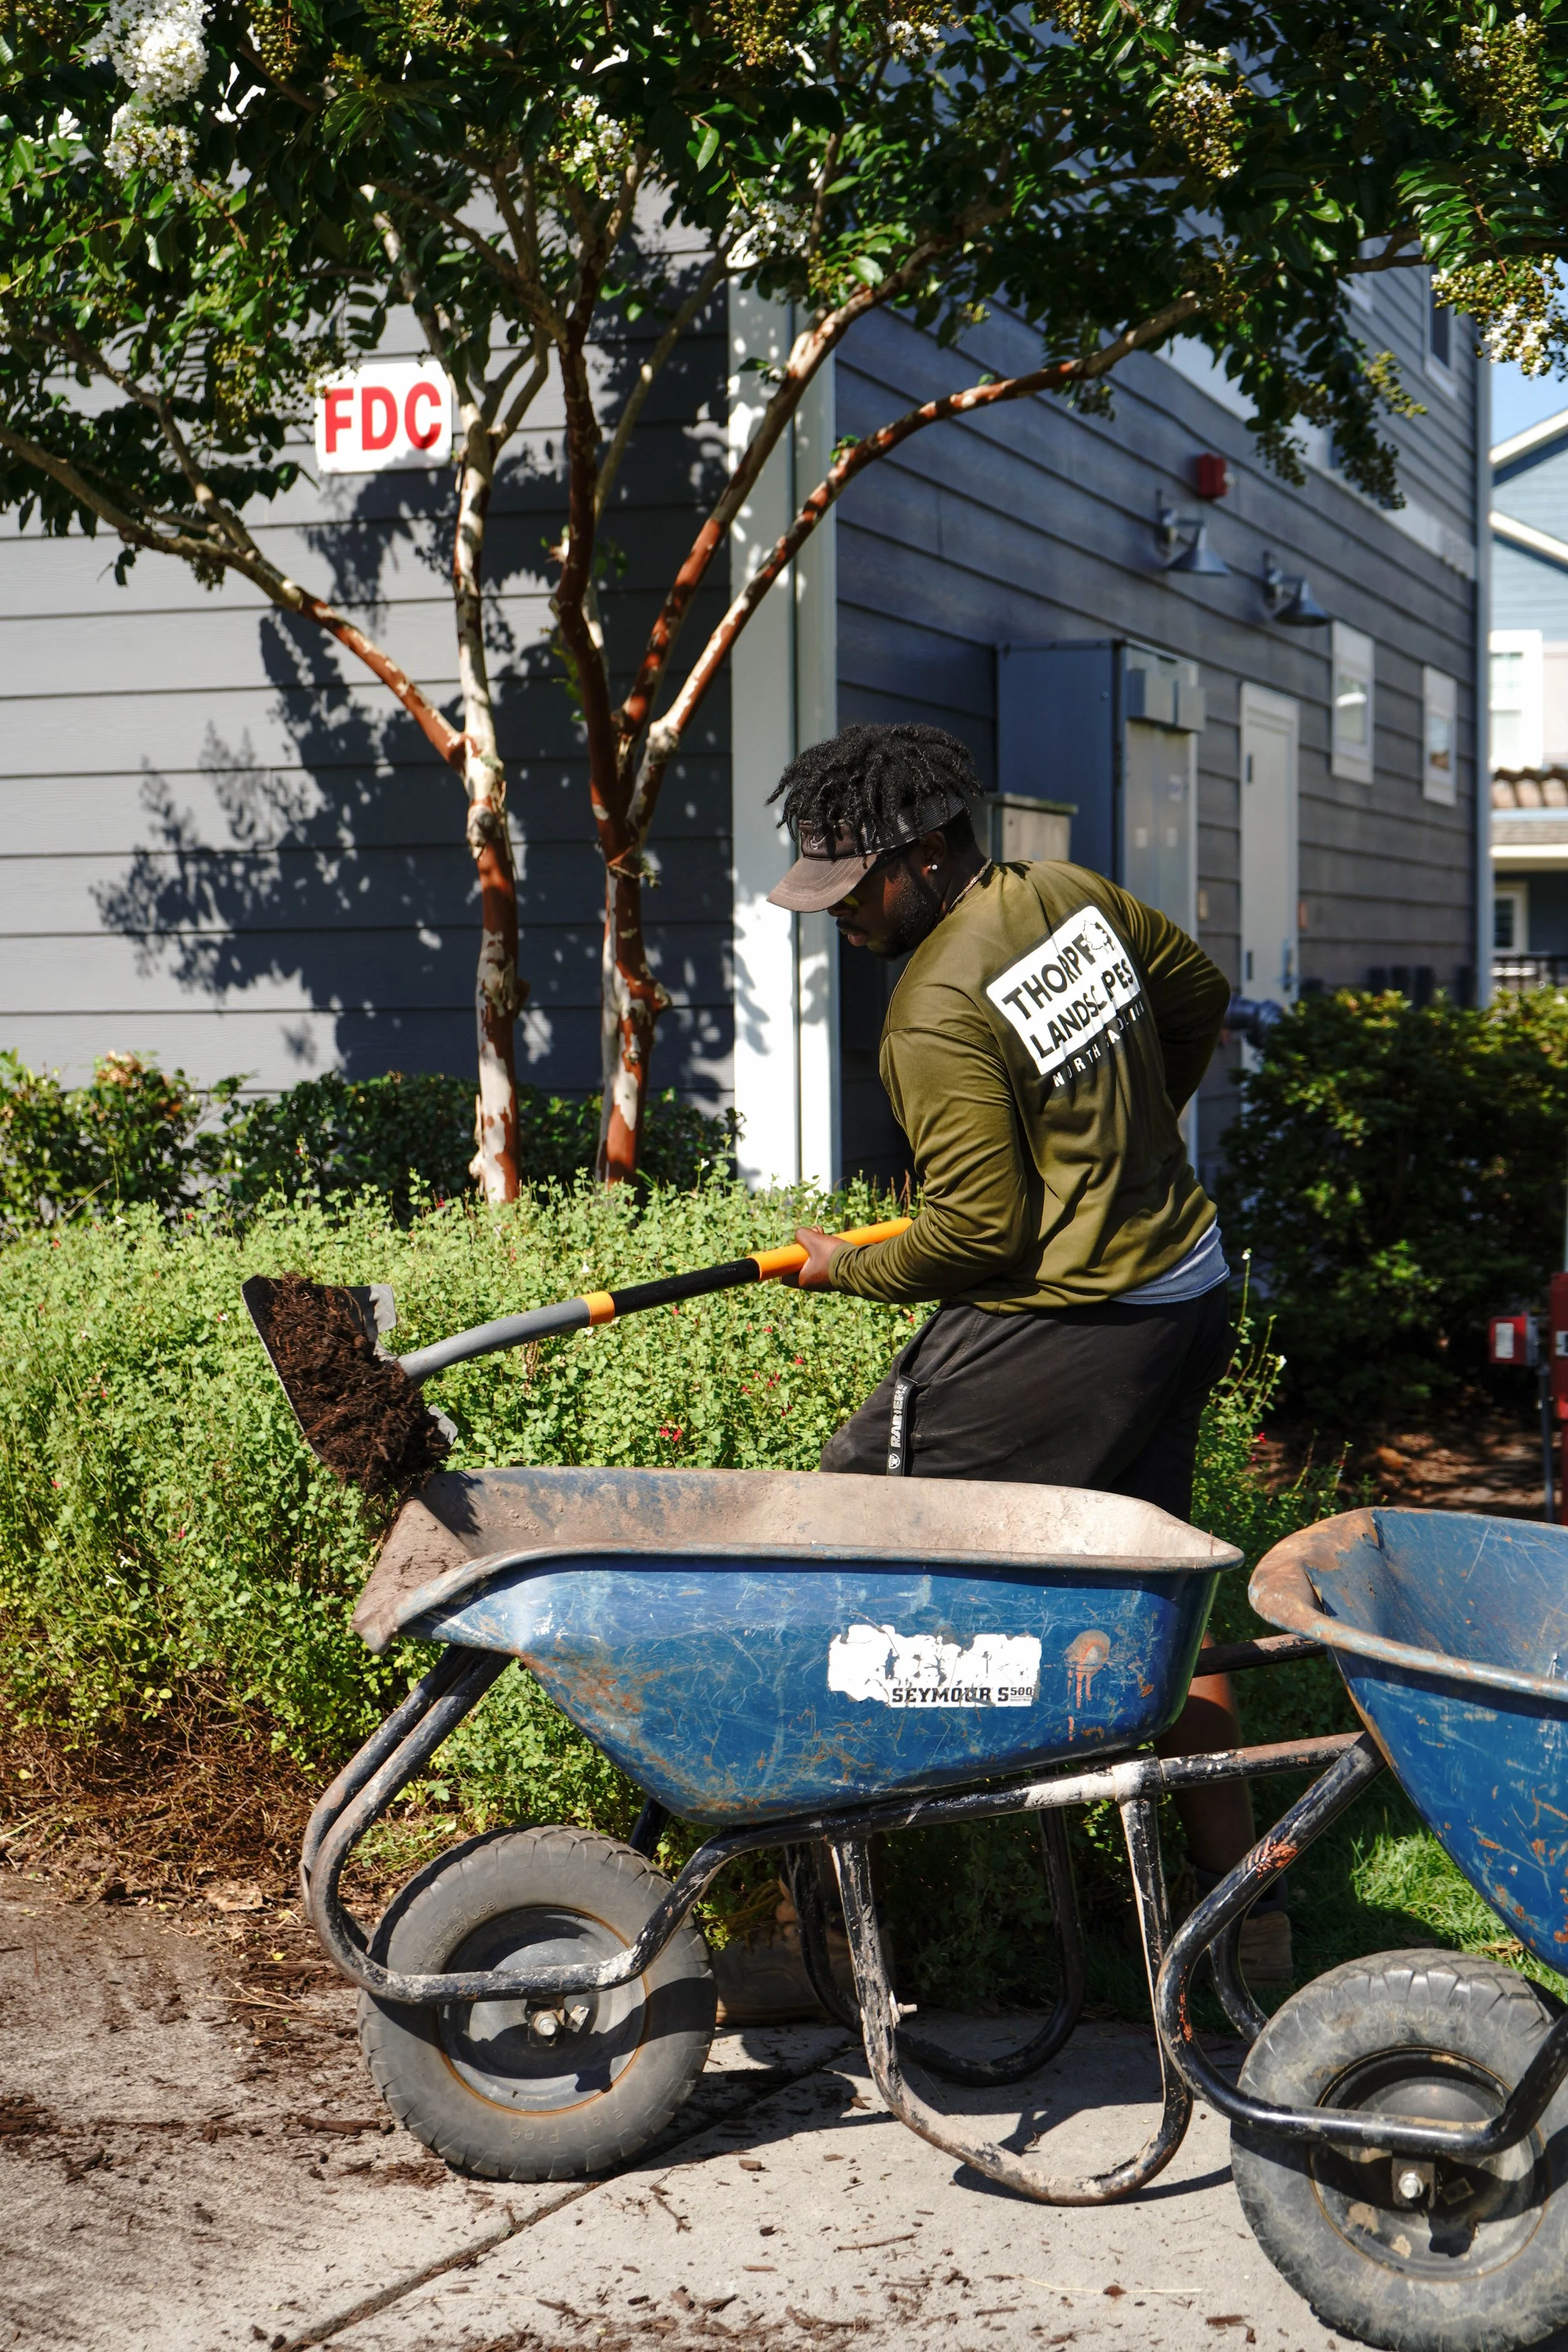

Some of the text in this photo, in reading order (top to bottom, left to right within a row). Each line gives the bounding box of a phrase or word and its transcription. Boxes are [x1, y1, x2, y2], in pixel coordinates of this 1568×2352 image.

[324, 381, 442, 453] FDC
[1029, 958, 1133, 1059] LANDSCPES
[890, 1384, 908, 1448] RAIDERS
[892, 1687, 992, 1703] SEYMOUR
[469, 1900, 497, 1921] Use
